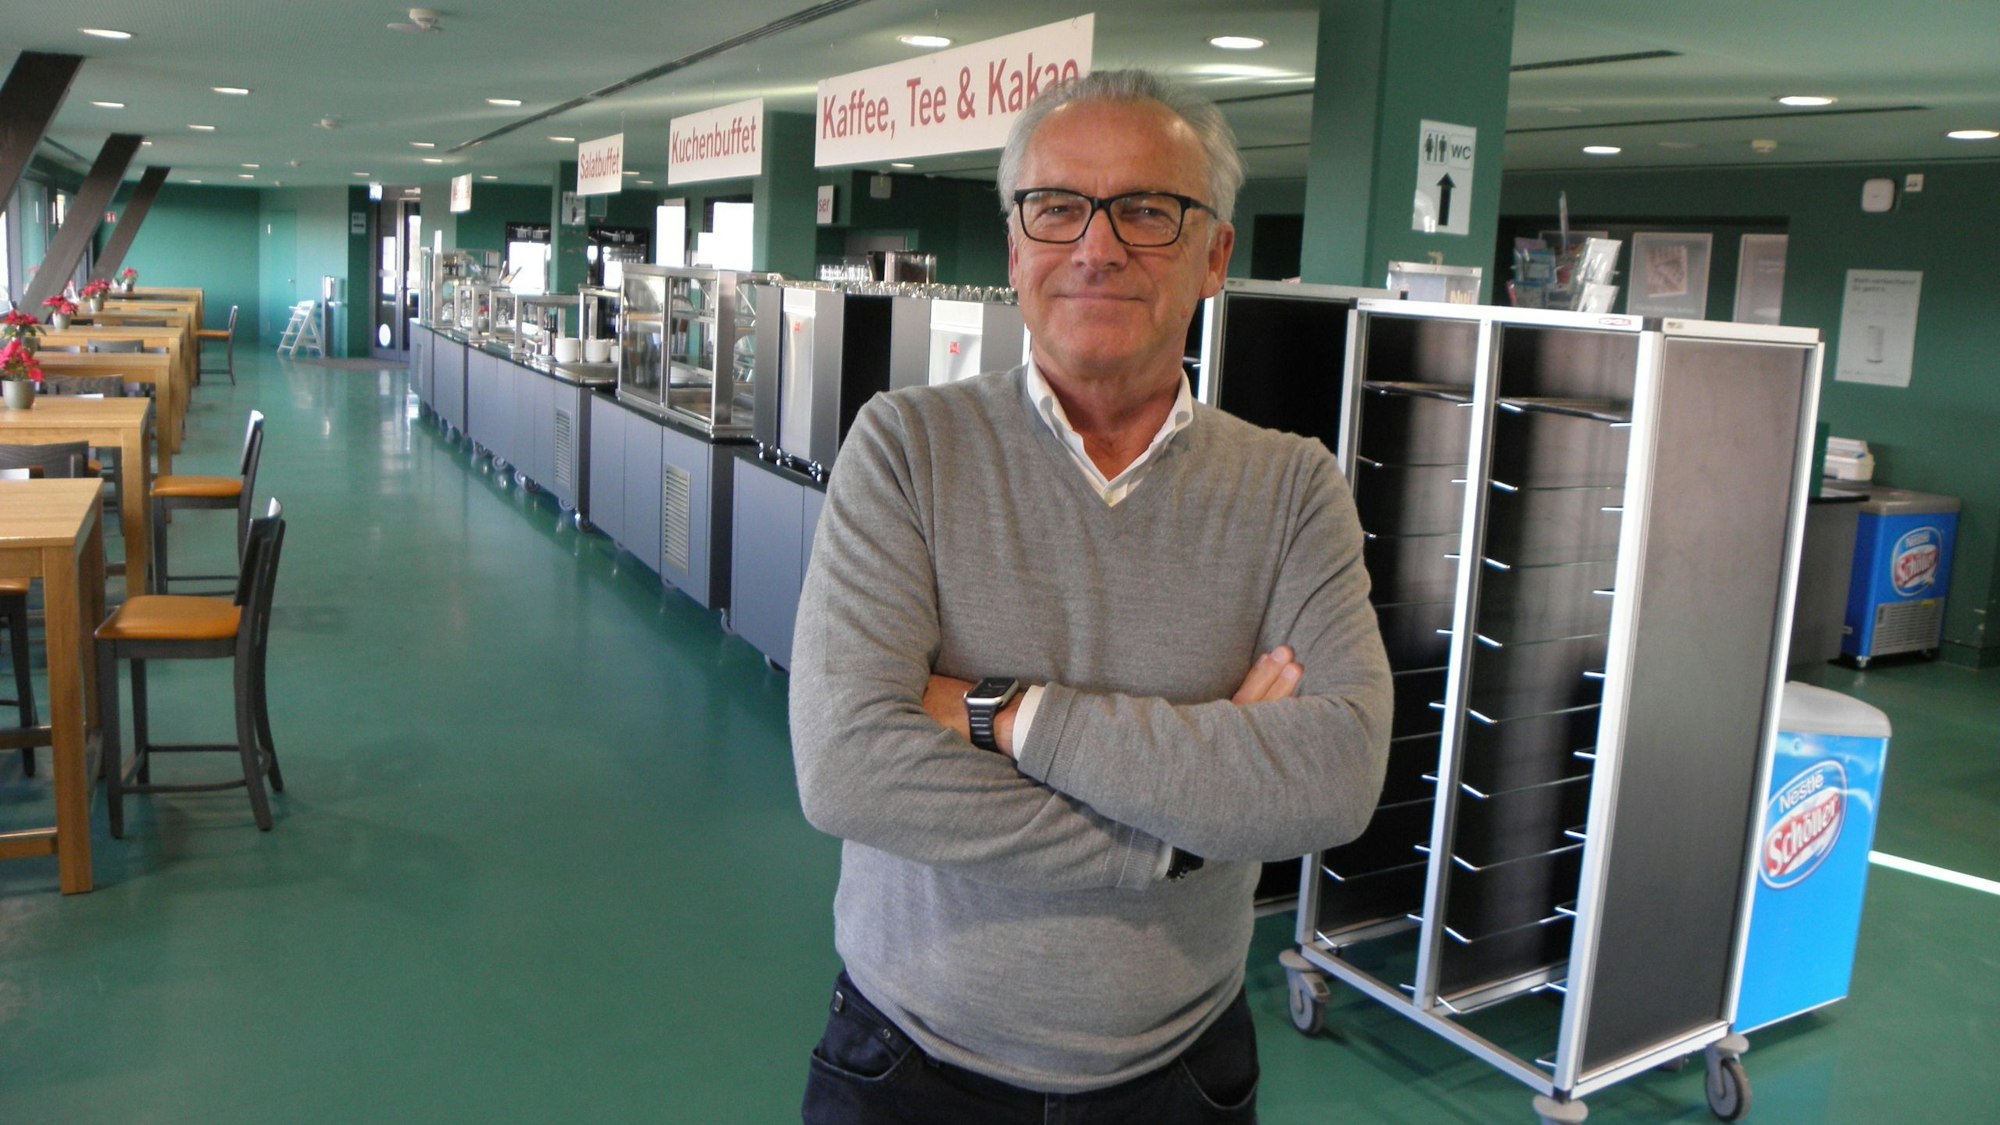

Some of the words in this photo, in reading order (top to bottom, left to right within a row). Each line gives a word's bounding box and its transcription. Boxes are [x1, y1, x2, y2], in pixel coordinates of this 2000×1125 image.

[822, 88, 896, 140] Kaffee,
[906, 77, 947, 128] Tee
[957, 66, 976, 120] &
[671, 115, 757, 165] Kuchenbuffet
[1451, 143, 1471, 160] WC
[580, 148, 620, 180] Salatbuffet
[1779, 769, 1824, 814] Nestlé
[1767, 795, 1840, 877] Schöller
